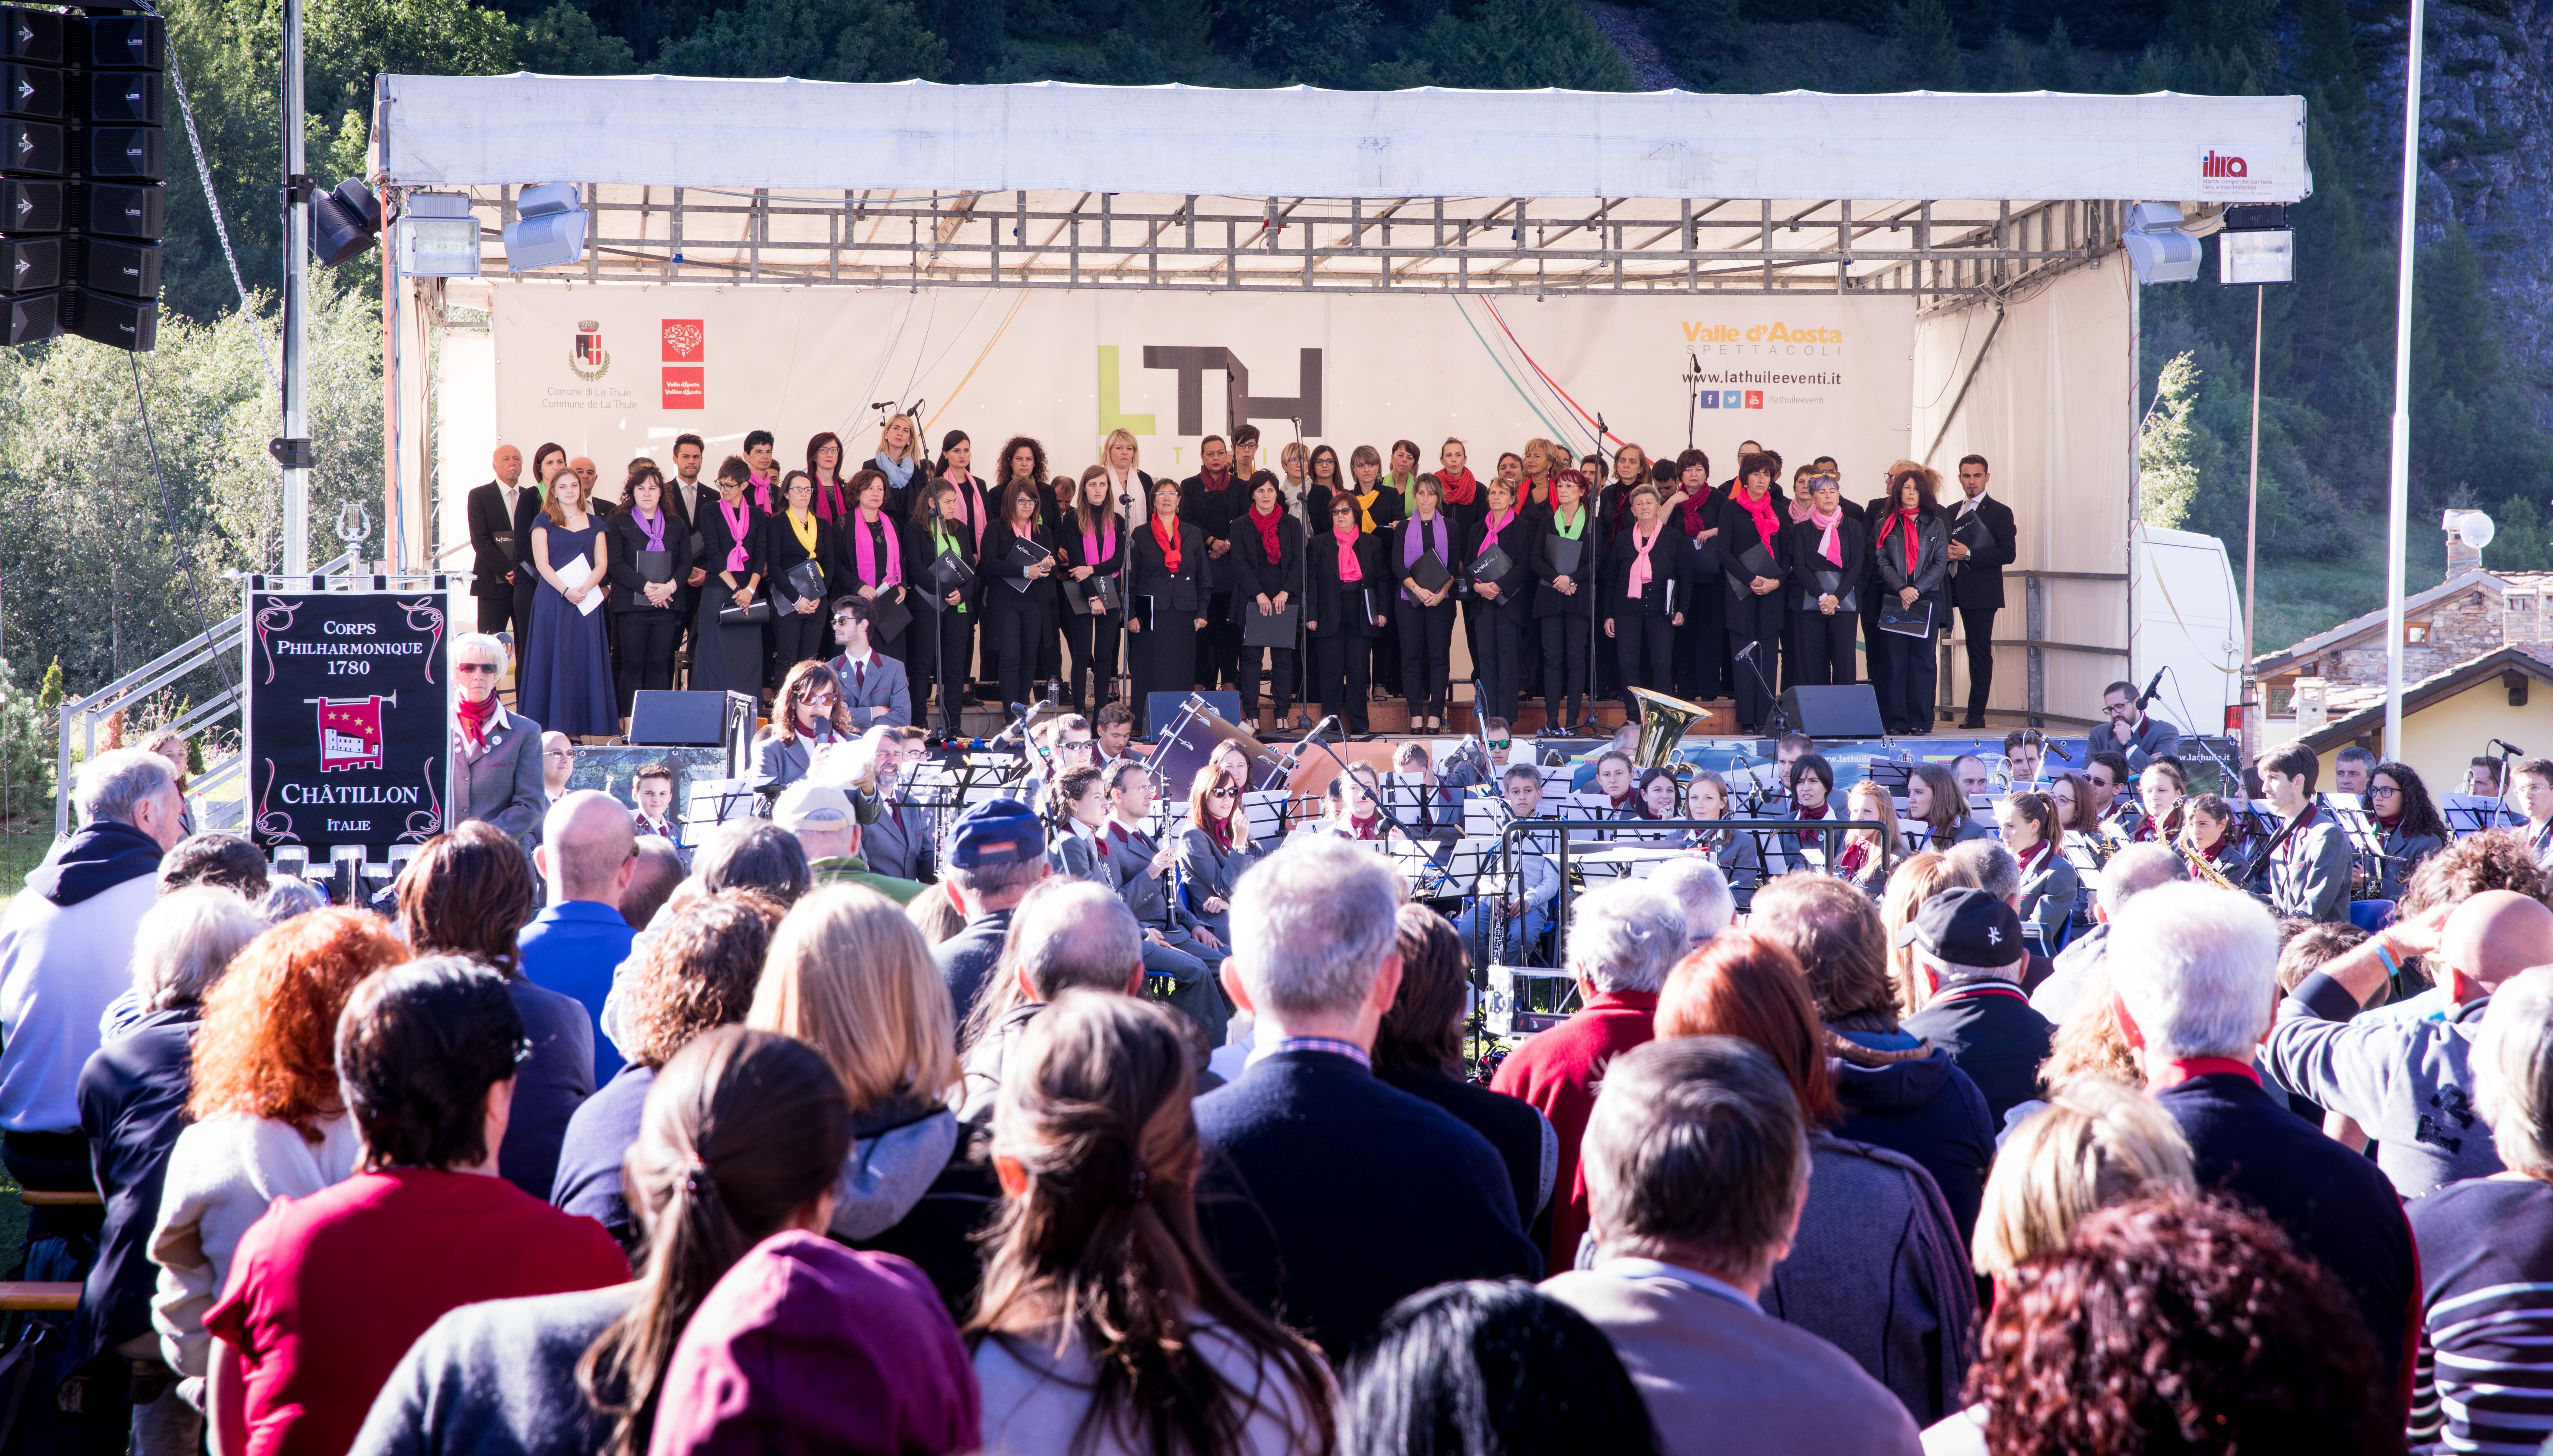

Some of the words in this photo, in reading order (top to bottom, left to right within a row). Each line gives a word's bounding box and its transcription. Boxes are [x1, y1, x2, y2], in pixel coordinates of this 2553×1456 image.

[1681, 321, 1739, 342] Valle
[1746, 322, 1843, 343] d'Aosta
[1686, 344, 1841, 356] SPETTACOLI
[1682, 370, 1841, 385] www.lathuileeventi.it
[548, 387, 582, 396] Comune
[585, 388, 592, 396] di
[595, 388, 605, 396] La
[608, 388, 632, 396] Thuile
[542, 399, 584, 408] Commune
[587, 400, 597, 408] de
[601, 400, 611, 408] La
[614, 400, 638, 409] Thuile
[327, 661, 370, 674] 1780
